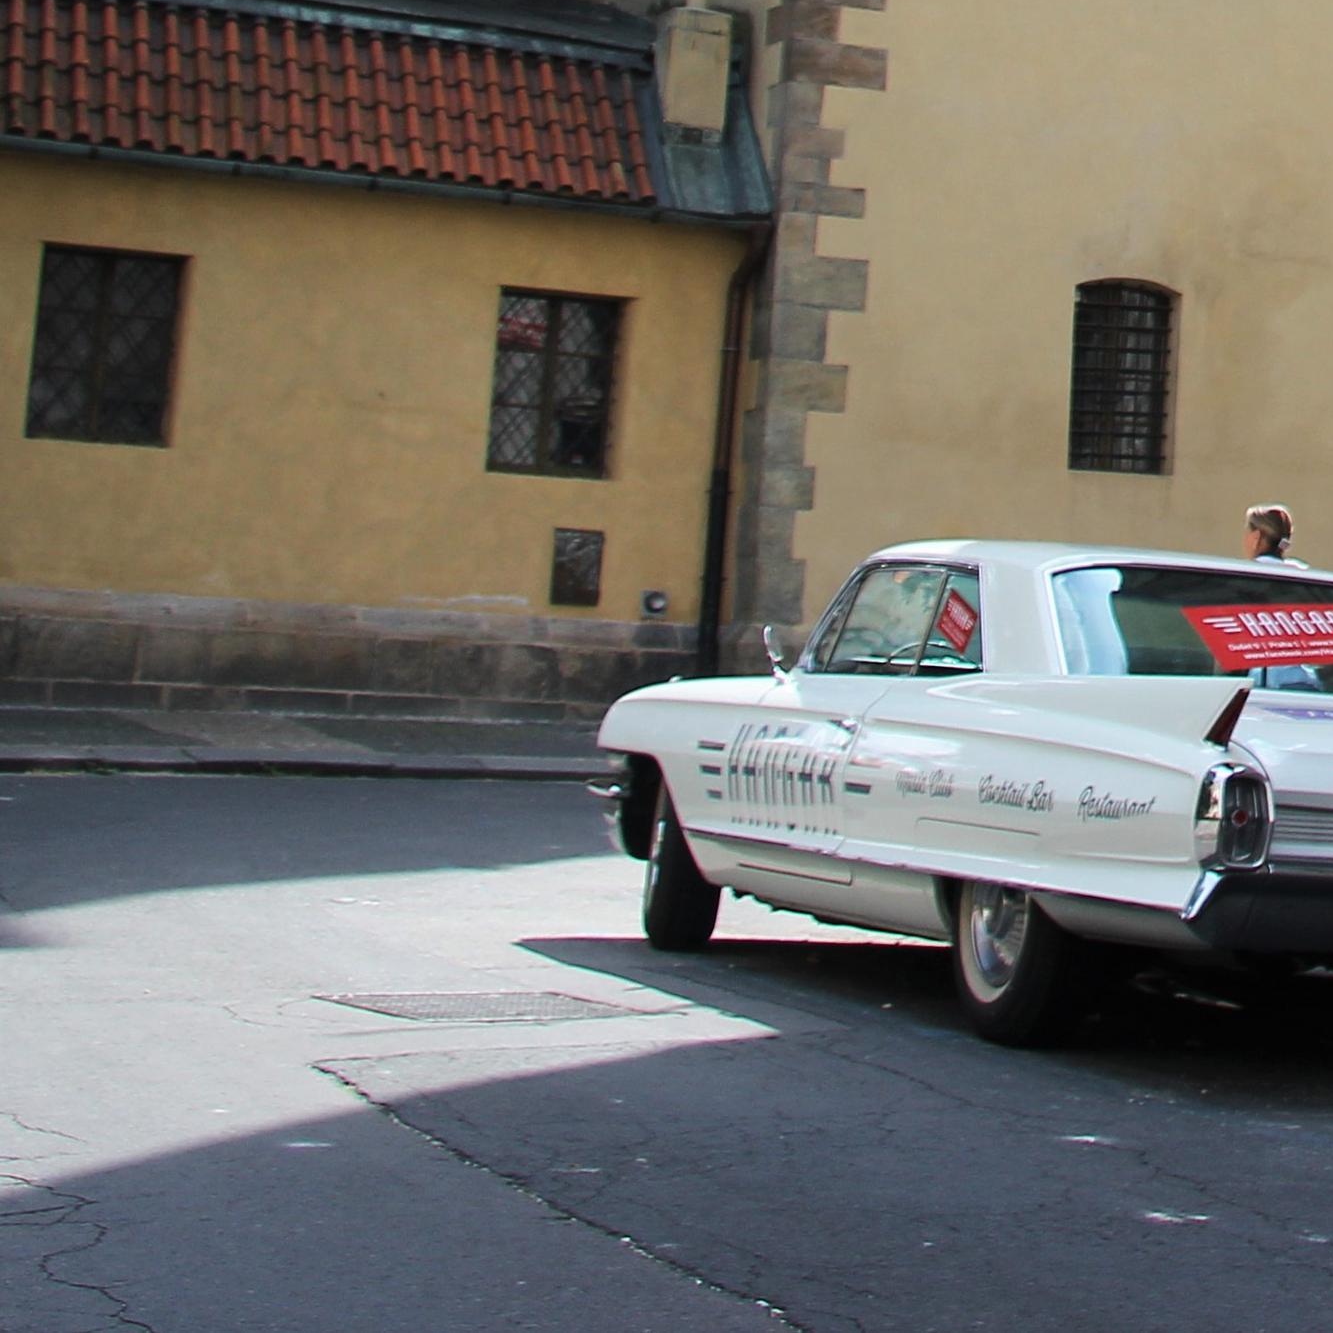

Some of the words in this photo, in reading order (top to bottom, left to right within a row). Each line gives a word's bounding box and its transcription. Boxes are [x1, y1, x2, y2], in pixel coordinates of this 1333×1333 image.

[978, 774, 1029, 808] Cocktail
[1026, 779, 1054, 811] Bar
[1077, 785, 1157, 822] Restaurant
